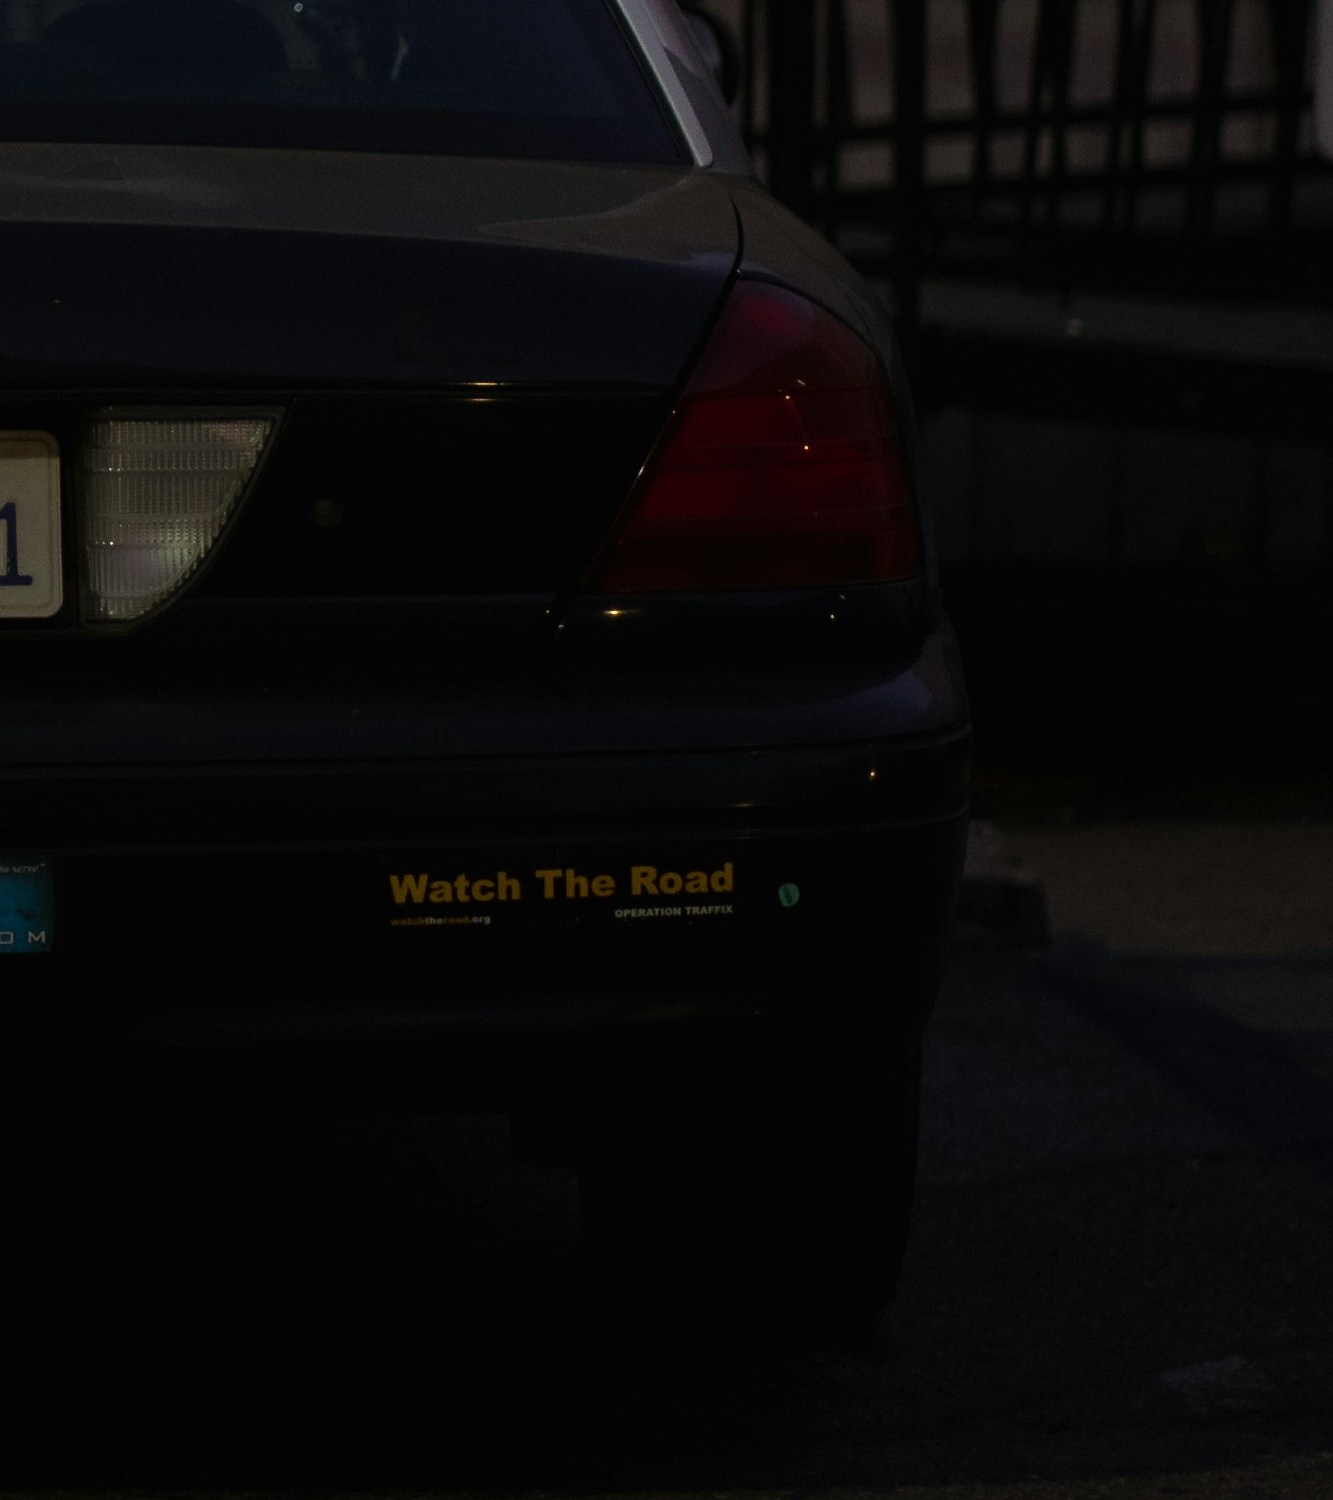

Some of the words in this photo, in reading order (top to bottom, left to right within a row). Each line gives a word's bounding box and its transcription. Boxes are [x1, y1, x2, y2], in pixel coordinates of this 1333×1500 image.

[389, 871, 521, 904] Watch
[535, 868, 616, 899] The
[630, 862, 734, 896] Road
[614, 907, 682, 919] OPERATION
[685, 904, 734, 917] TRAFFIX
[390, 914, 492, 927] watchtheroad.org
